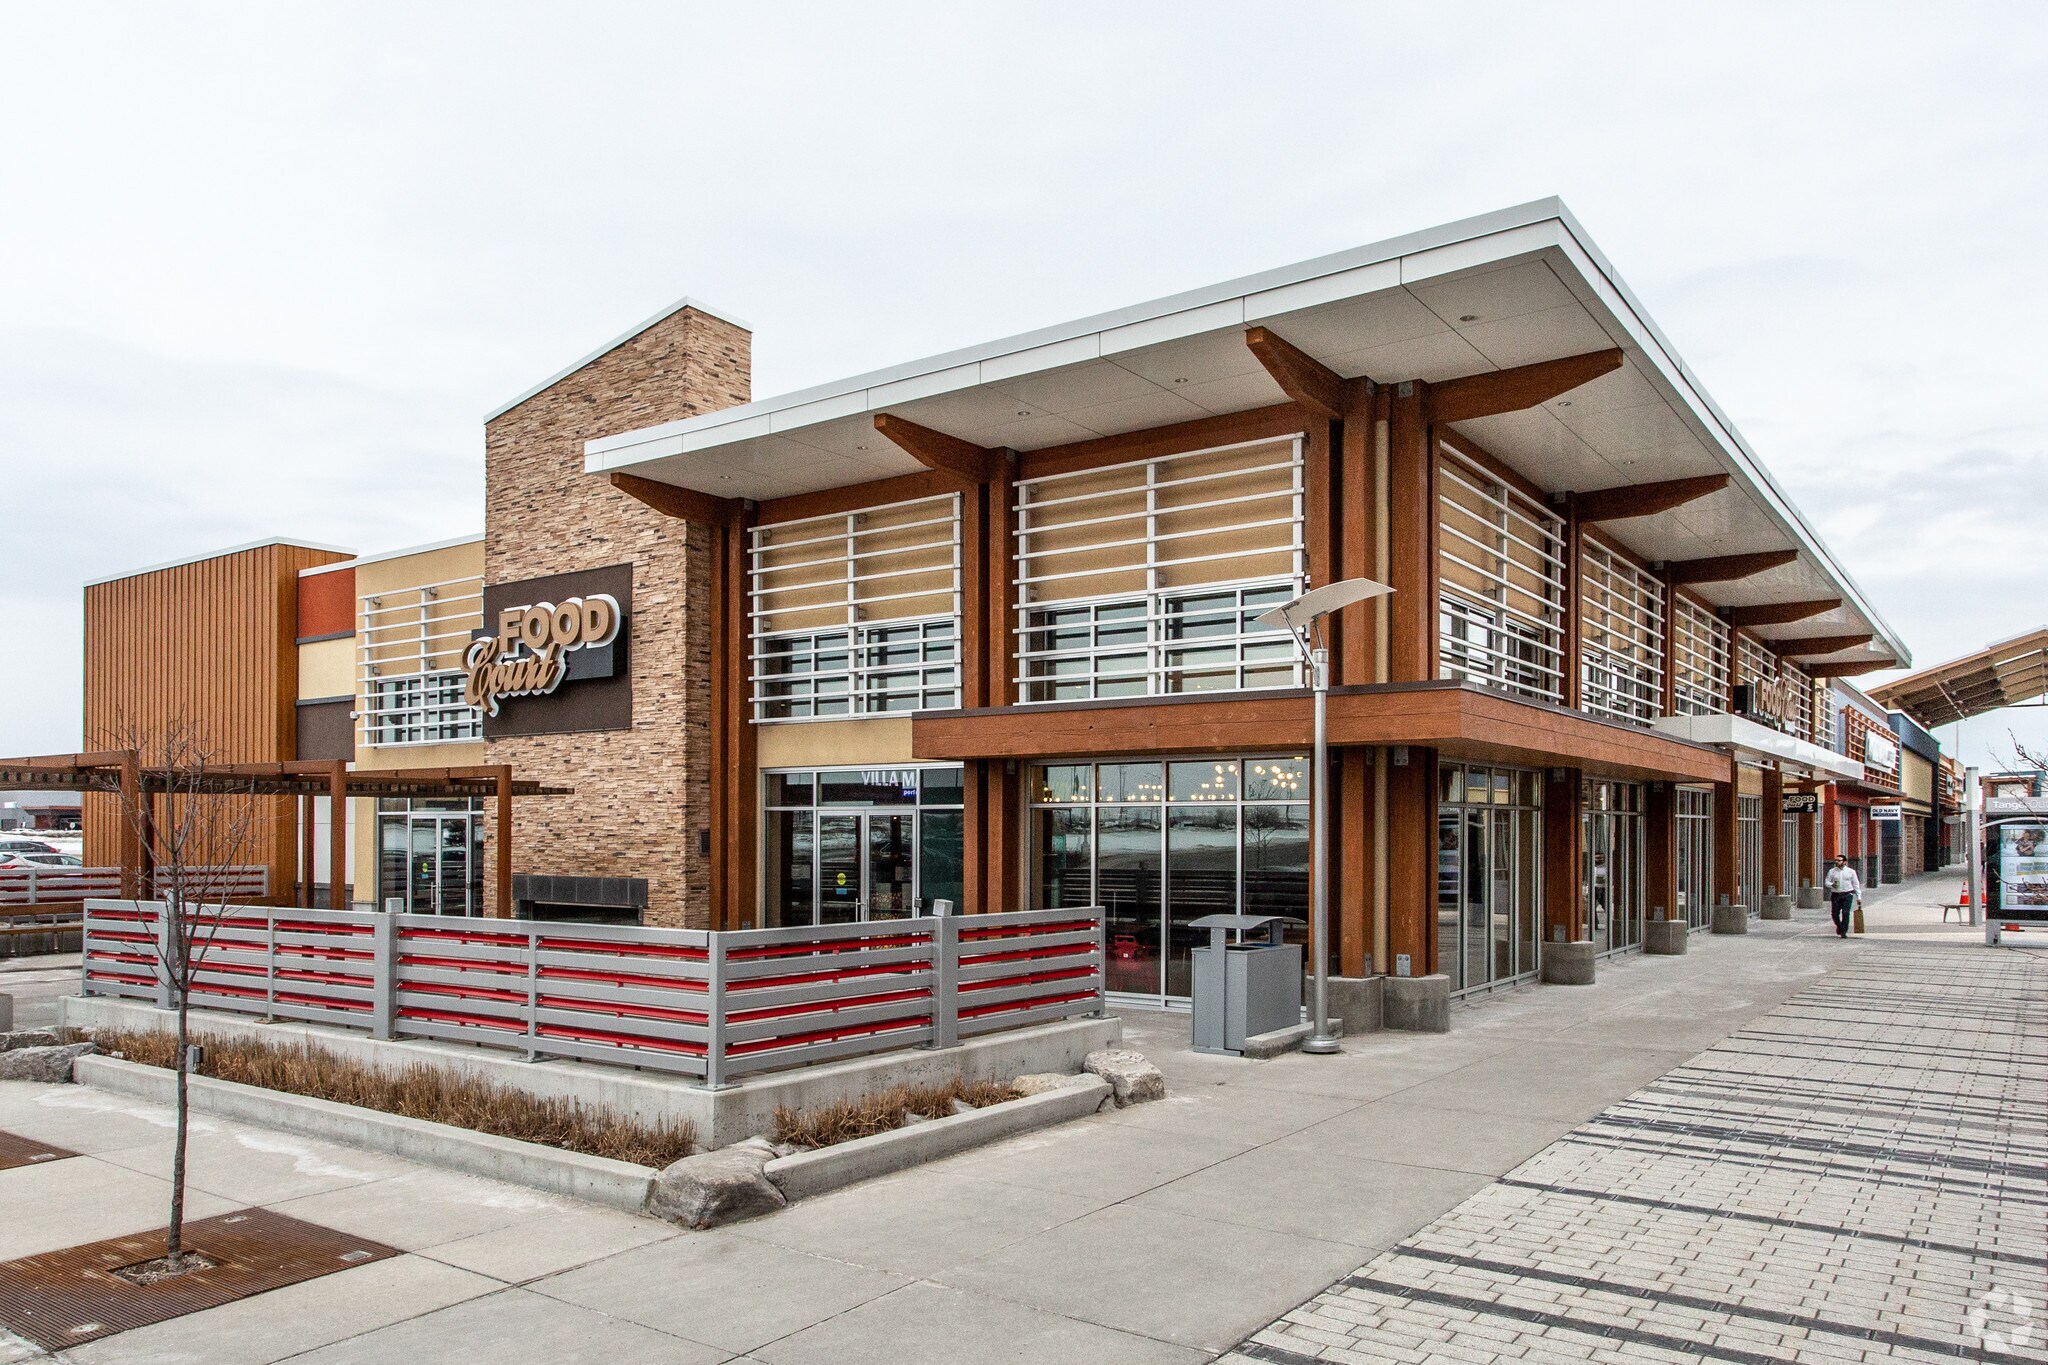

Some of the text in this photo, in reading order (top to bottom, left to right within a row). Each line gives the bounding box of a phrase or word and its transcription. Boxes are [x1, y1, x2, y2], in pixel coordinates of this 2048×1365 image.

[499, 594, 620, 657] FOOD
[461, 637, 566, 717] Court
[862, 771, 917, 787] VILLA M
[1789, 795, 1816, 804] FOOD
